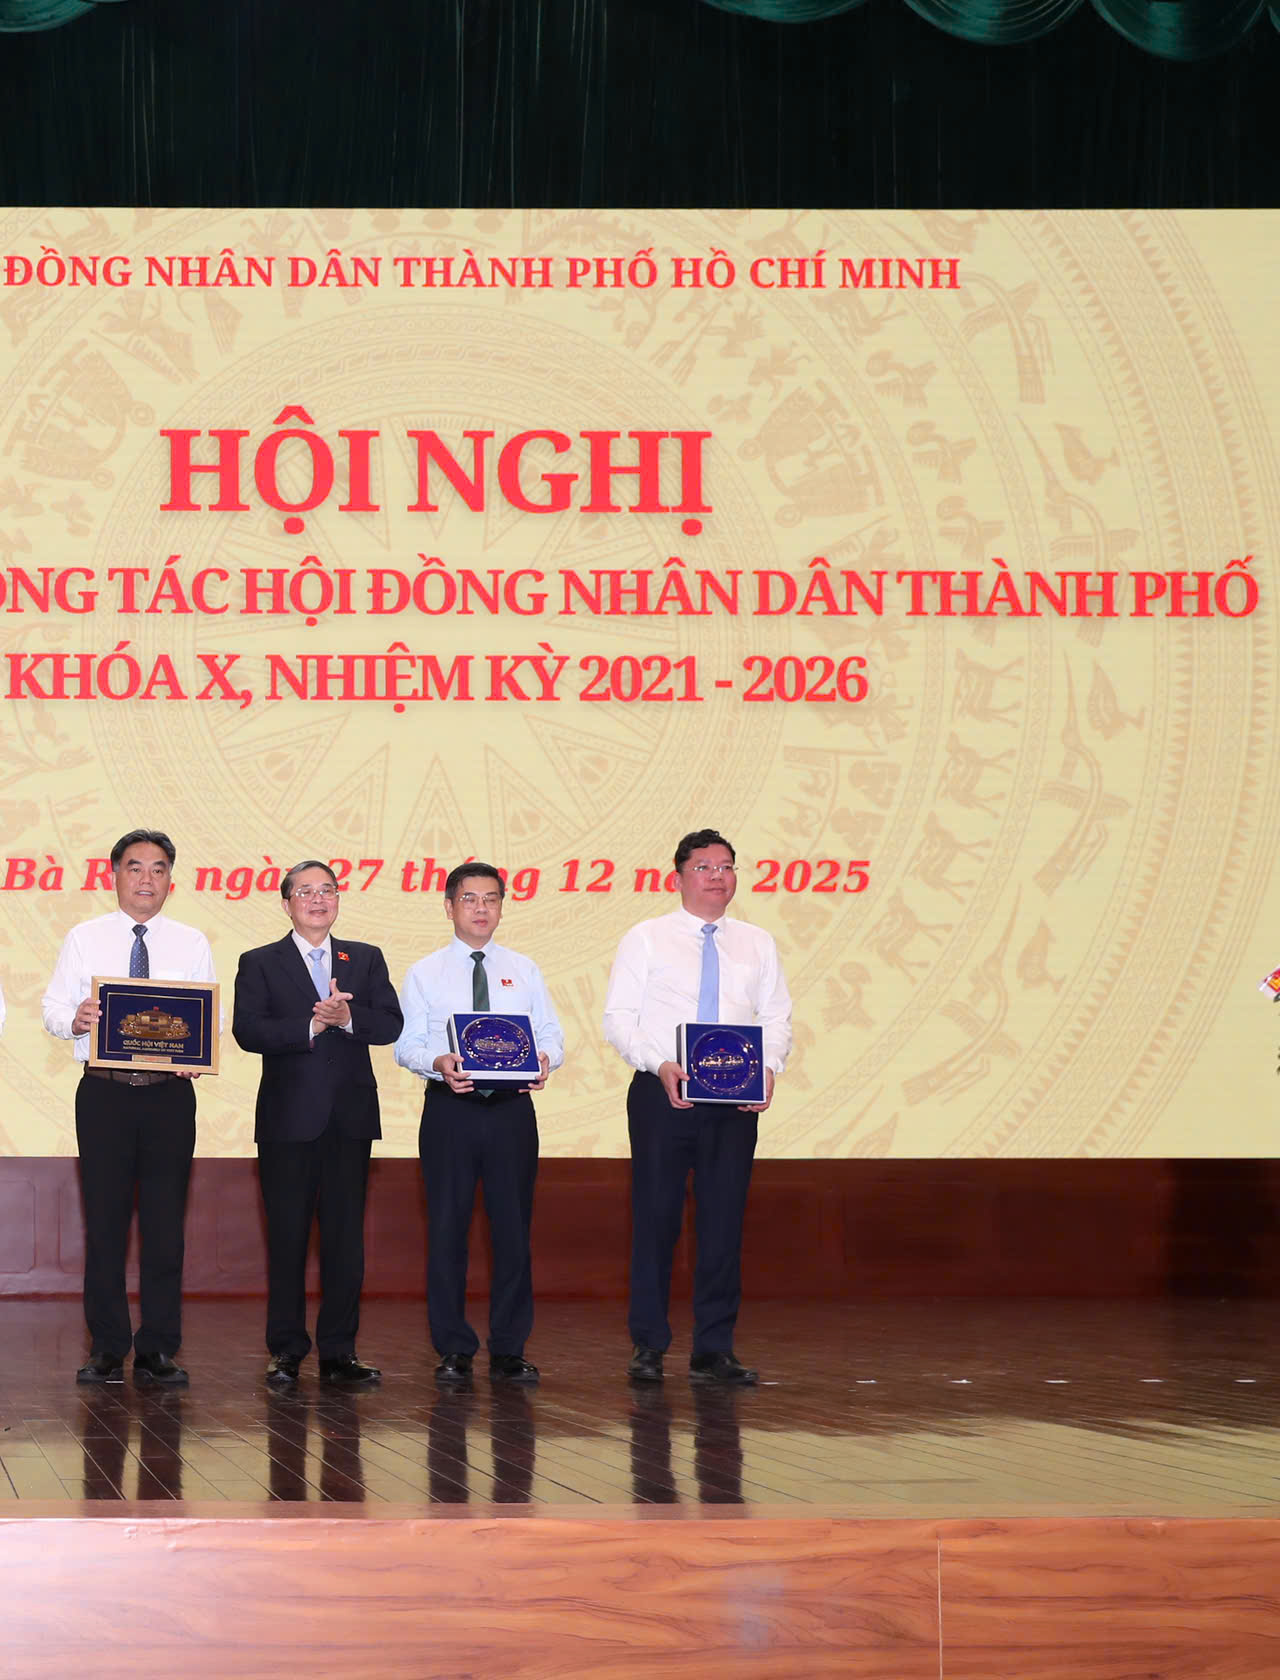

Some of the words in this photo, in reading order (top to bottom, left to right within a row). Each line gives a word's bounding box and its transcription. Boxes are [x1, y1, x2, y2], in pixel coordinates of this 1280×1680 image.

[3, 246, 132, 288] ĐỒNG
[145, 247, 276, 288] NHÂN
[287, 247, 382, 288] DÂN
[393, 248, 555, 289] THÀNH
[566, 247, 659, 289] PHỐ
[671, 247, 737, 289] HỒ
[749, 248, 827, 289] CHÍ
[839, 257, 961, 290] MINH
[159, 405, 380, 535] HỘI
[406, 429, 714, 537] NGHỊ
[108, 554, 229, 615] TÁC
[239, 554, 357, 627] HỘI
[367, 552, 549, 617] ĐỒNG
[558, 556, 743, 617] NHÂN
[752, 556, 888, 617] DÂN
[897, 557, 1120, 618] THÀNH
[1130, 554, 1260, 619] PHỐ
[4, 640, 188, 702] KHÓA
[195, 654, 253, 710] X,
[265, 642, 475, 714] NHIỆM
[485, 641, 571, 702] KỲ
[579, 655, 705, 703] 2021
[715, 679, 734, 689] -
[743, 655, 870, 704] 2026
[0, 855, 65, 892] Bà
[195, 855, 294, 901] ngà
[328, 858, 385, 893] 27
[559, 858, 616, 893] 12
[751, 859, 871, 894] 2025
